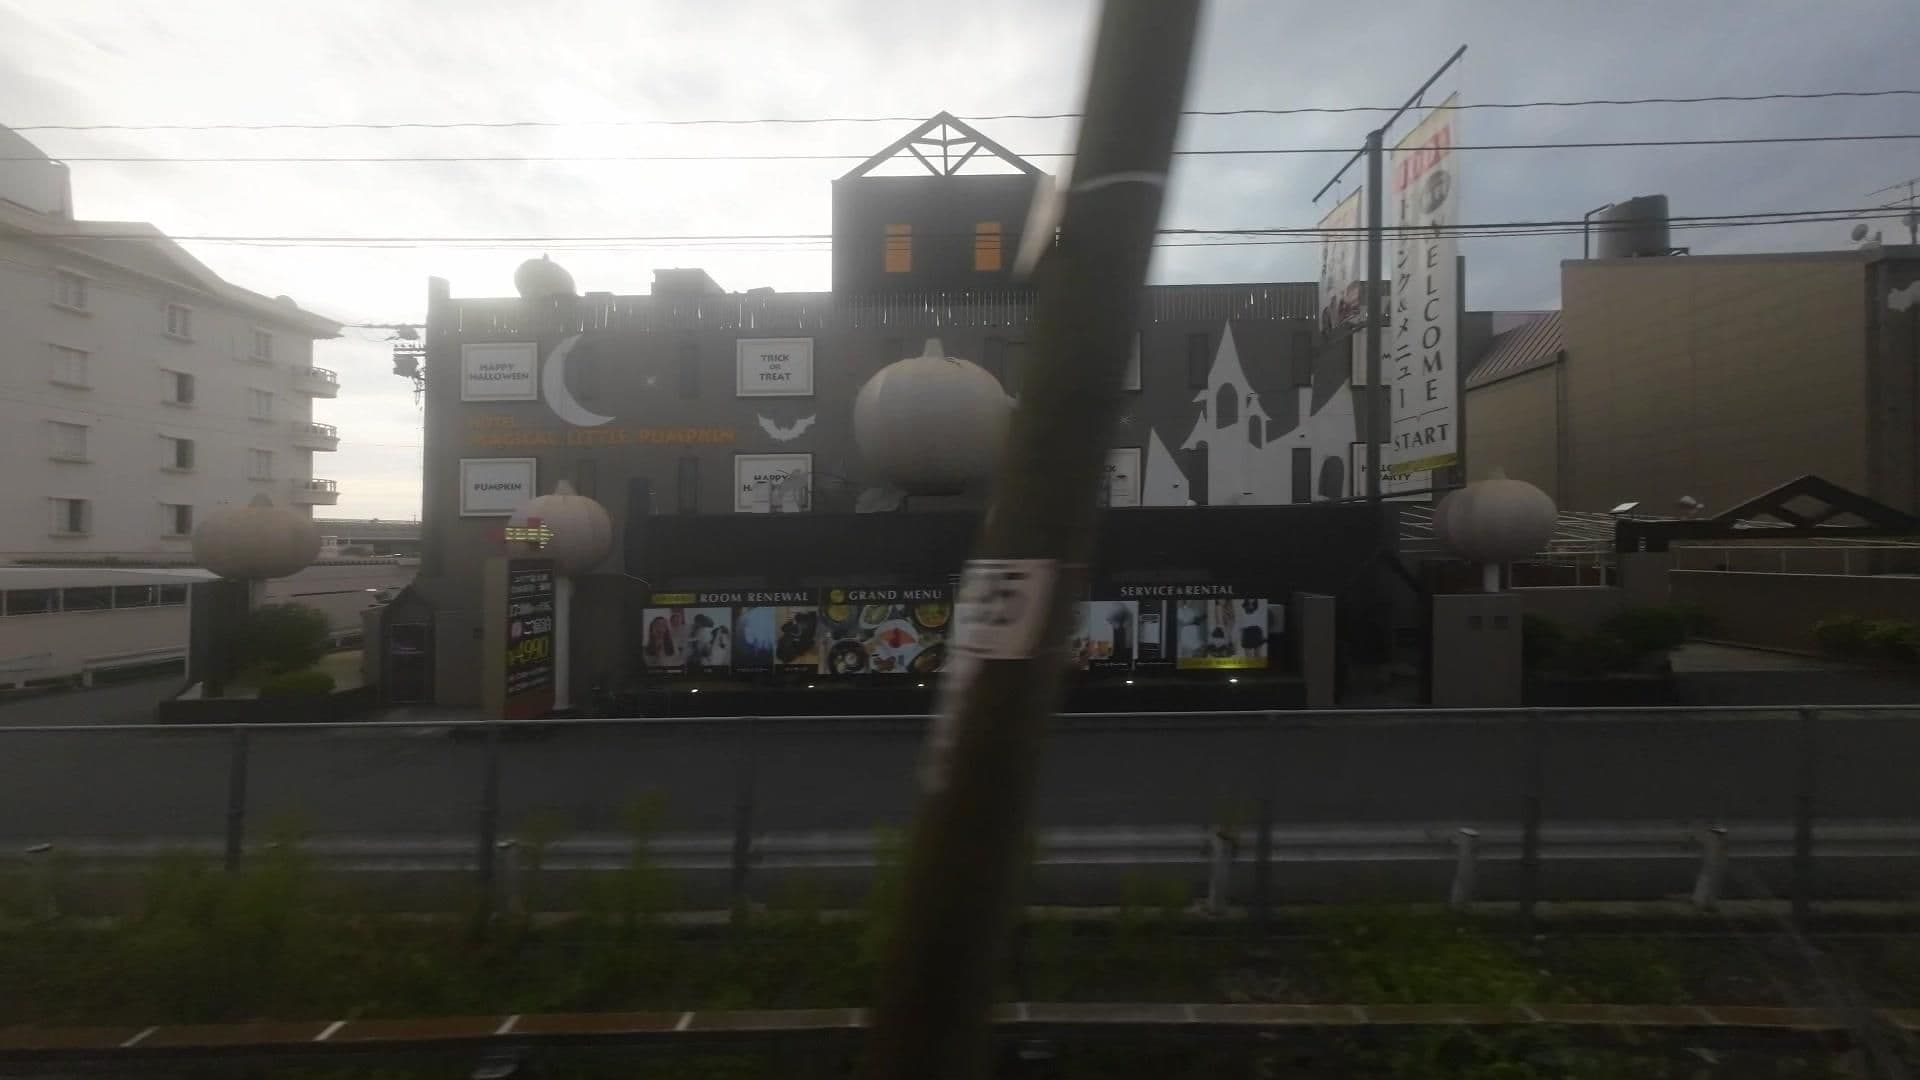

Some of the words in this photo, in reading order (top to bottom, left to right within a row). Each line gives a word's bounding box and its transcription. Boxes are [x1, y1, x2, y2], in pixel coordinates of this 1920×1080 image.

[1423, 219, 1442, 401] WELCOME
[760, 354, 790, 362] TRICK
[479, 363, 515, 372] HAPPY
[470, 372, 529, 381] HALLOWEEN
[759, 372, 792, 381] TREAT
[638, 428, 736, 444] PUMPKIN
[1394, 423, 1449, 451] START
[474, 482, 521, 491] PUMPKIN
[701, 593, 743, 603] ROOM
[748, 592, 809, 602] RENEWAL
[849, 590, 897, 600] GRAND
[903, 590, 942, 600] MENU
